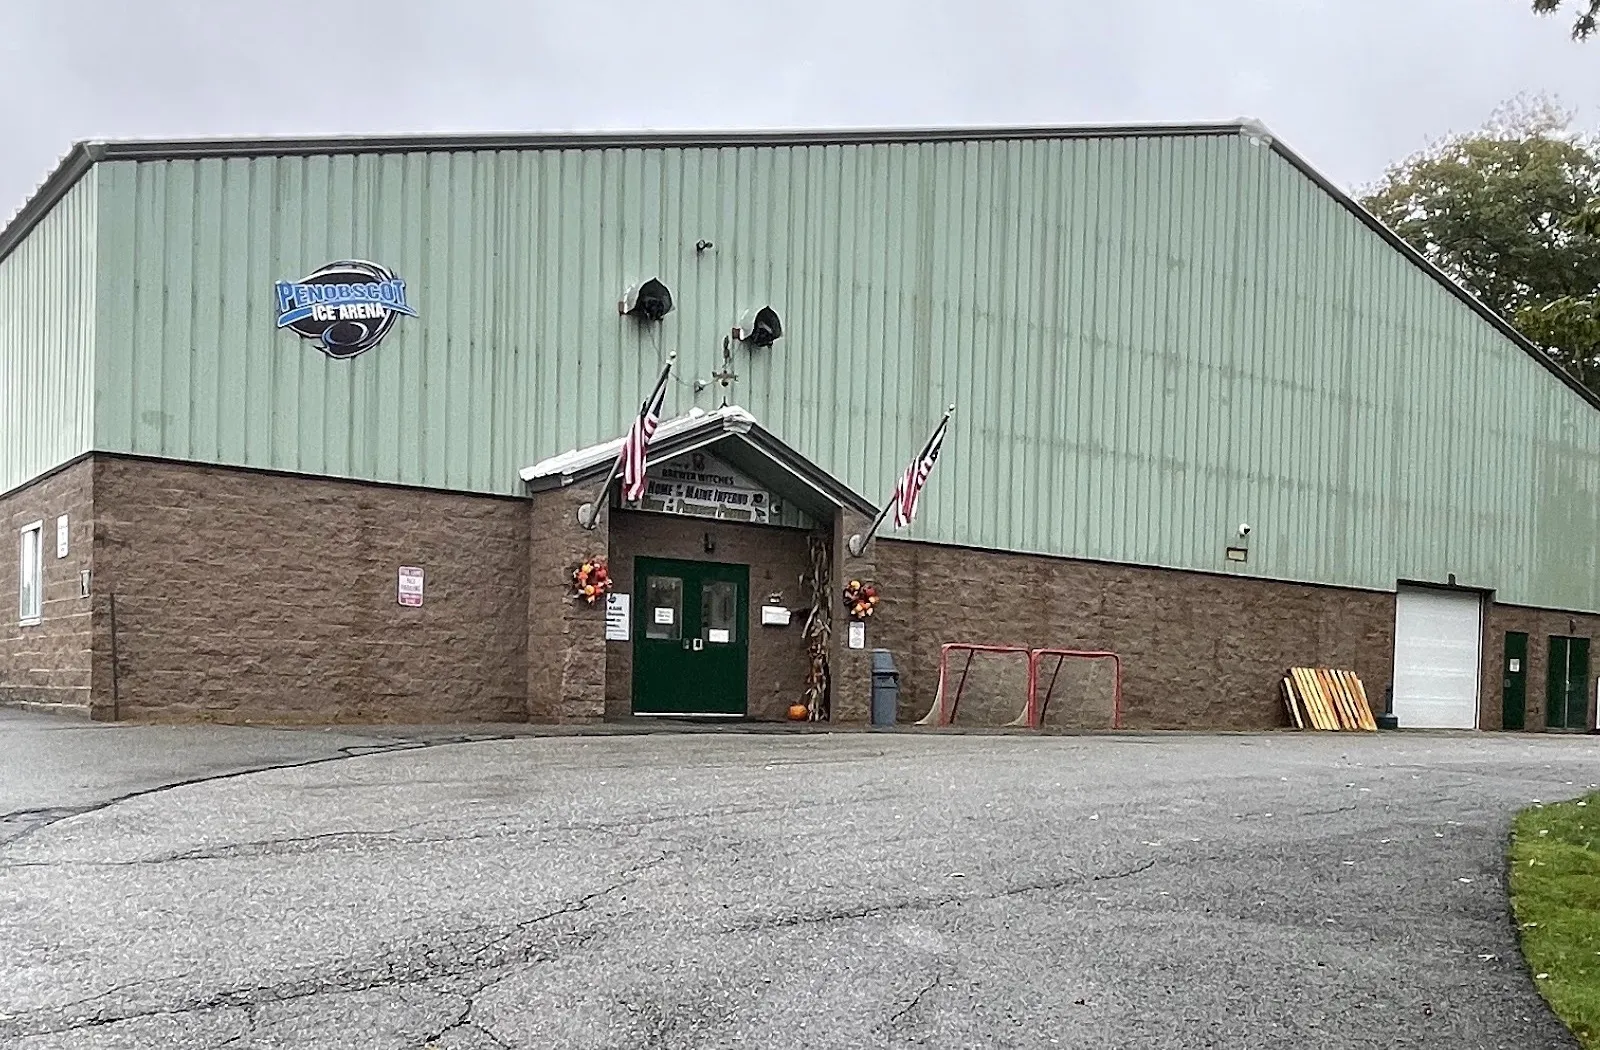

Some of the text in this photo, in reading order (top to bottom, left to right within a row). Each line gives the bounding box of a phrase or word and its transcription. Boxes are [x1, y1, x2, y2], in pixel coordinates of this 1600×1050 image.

[277, 281, 405, 312] PENOBSCOT
[311, 302, 386, 321] ICE ARENA
[662, 469, 734, 485] BREWER WITCHES
